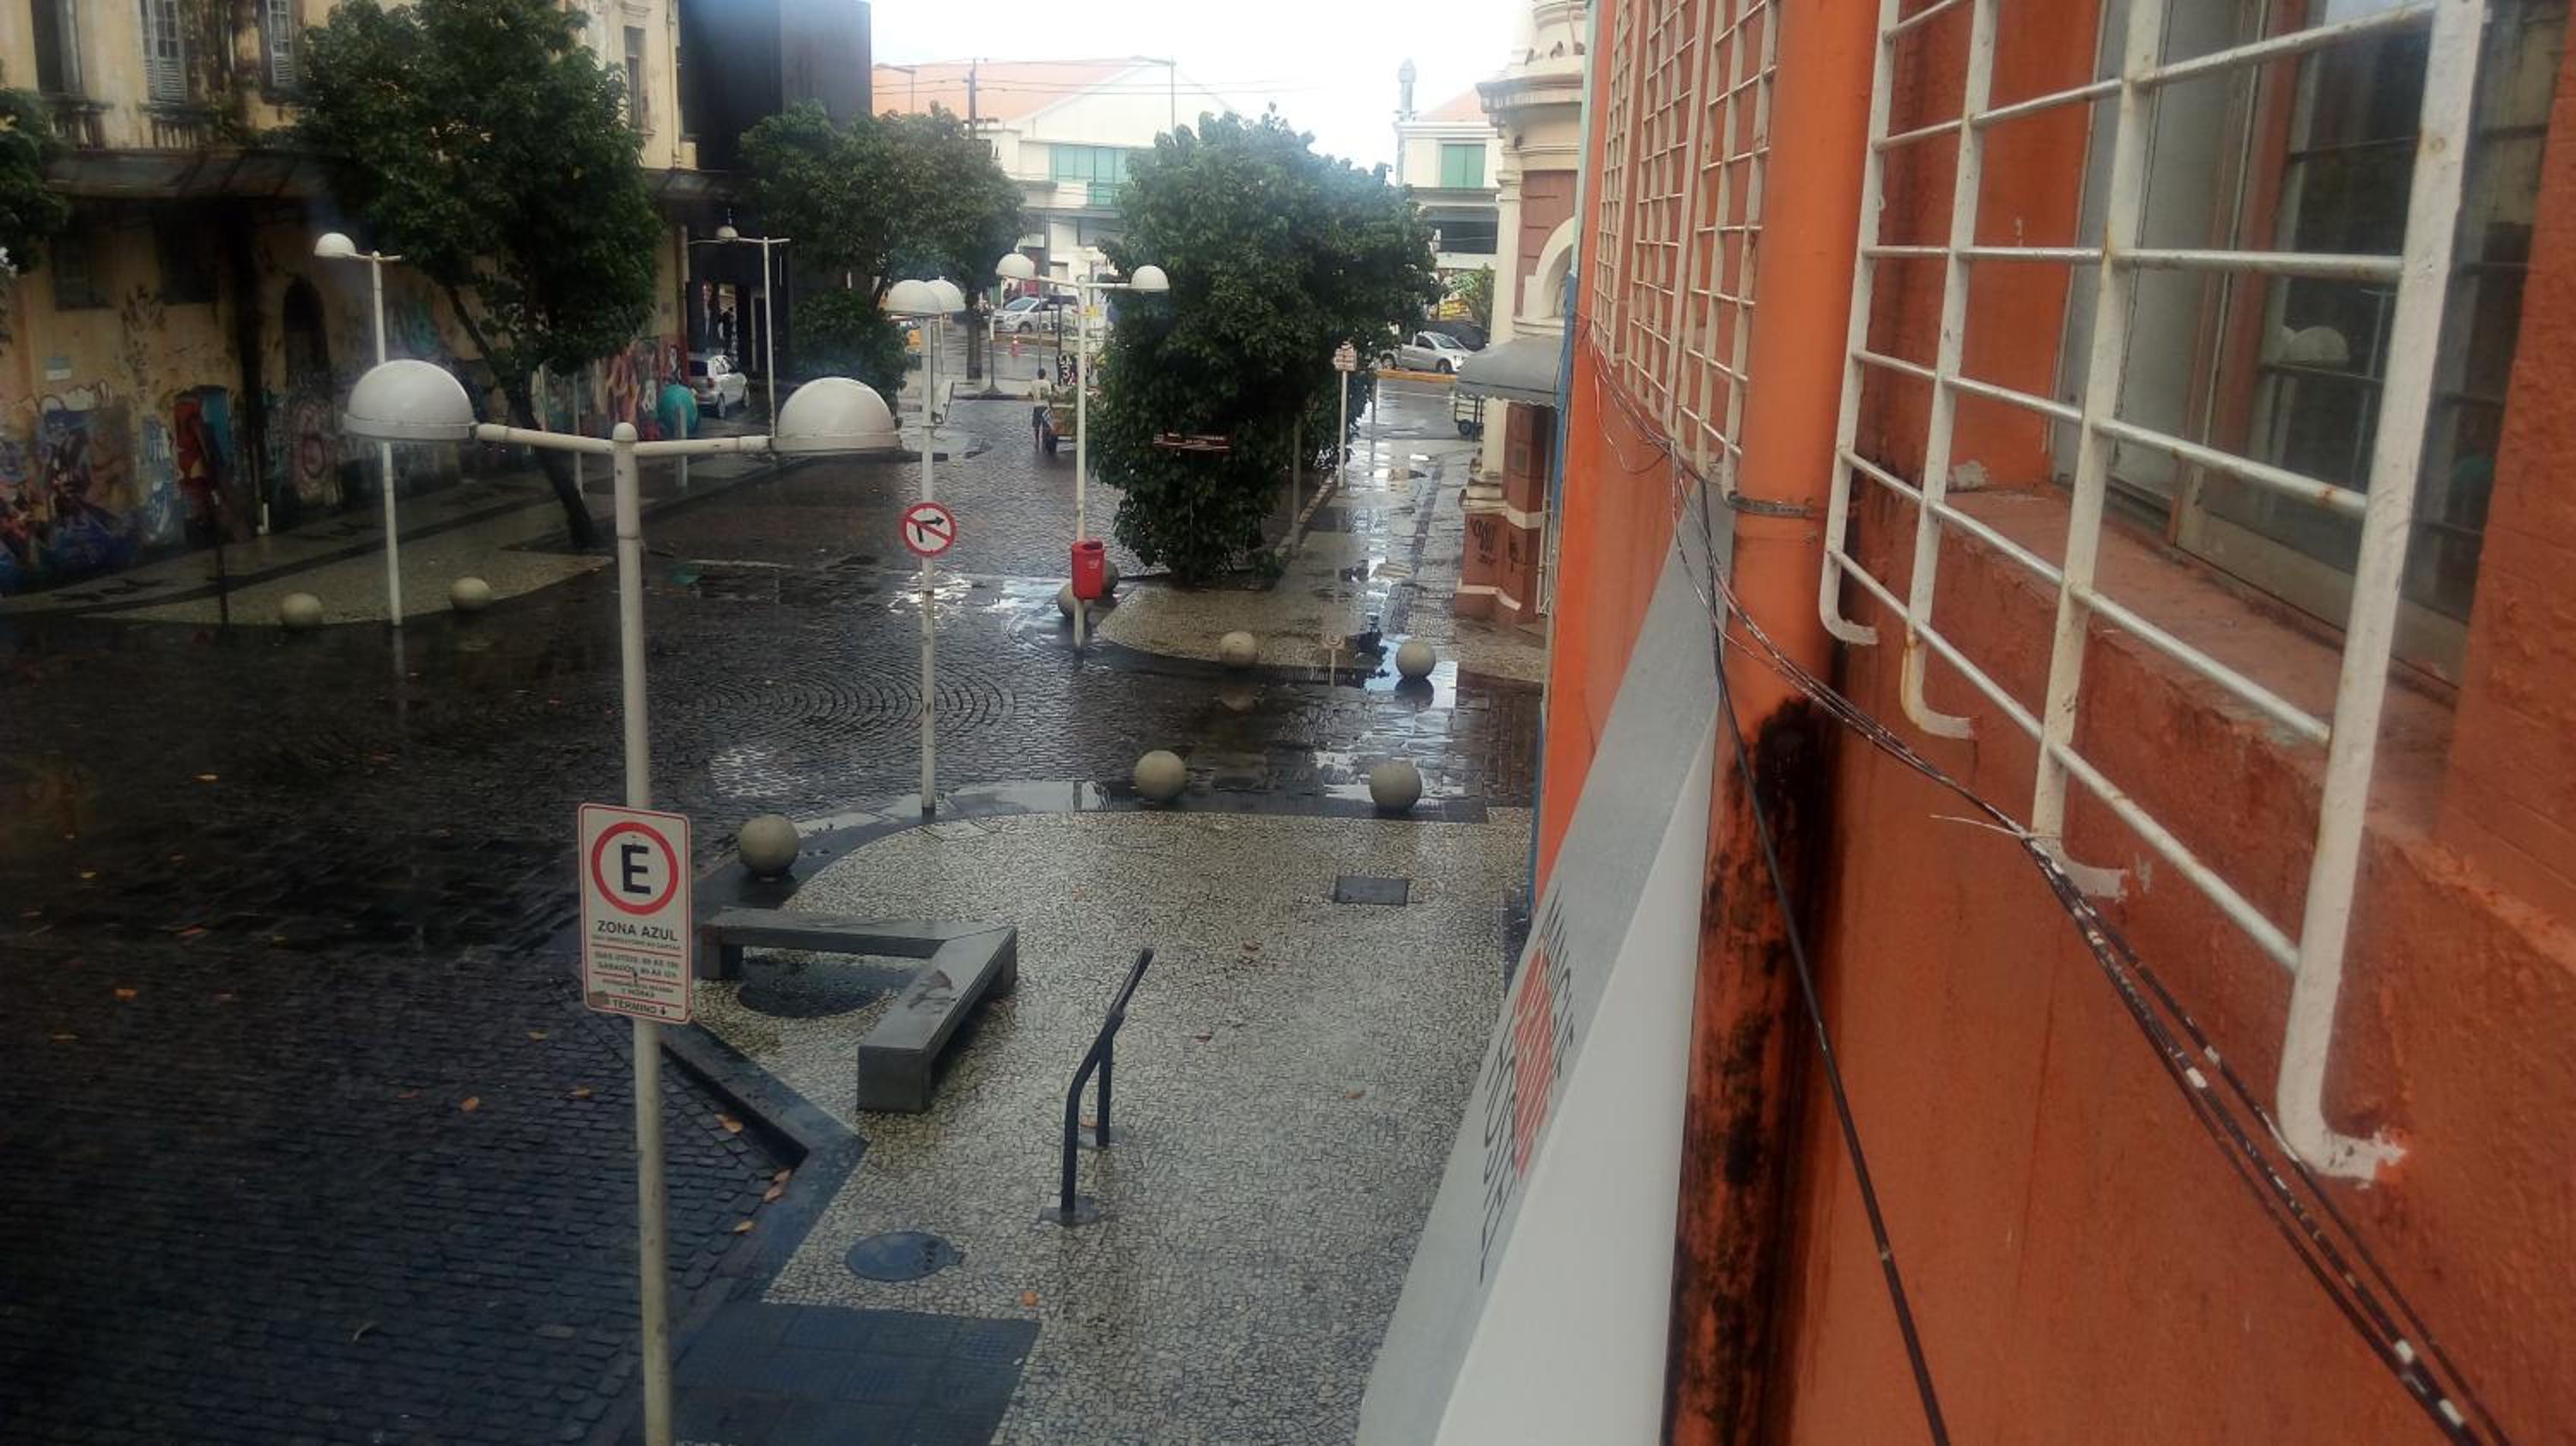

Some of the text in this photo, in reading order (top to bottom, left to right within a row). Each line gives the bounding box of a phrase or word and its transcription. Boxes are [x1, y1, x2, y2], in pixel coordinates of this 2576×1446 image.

[621, 843, 652, 895] E
[597, 920, 635, 935] ZONA
[641, 926, 678, 942] AZUL
[1479, 1010, 1518, 1285] HOSTEL
